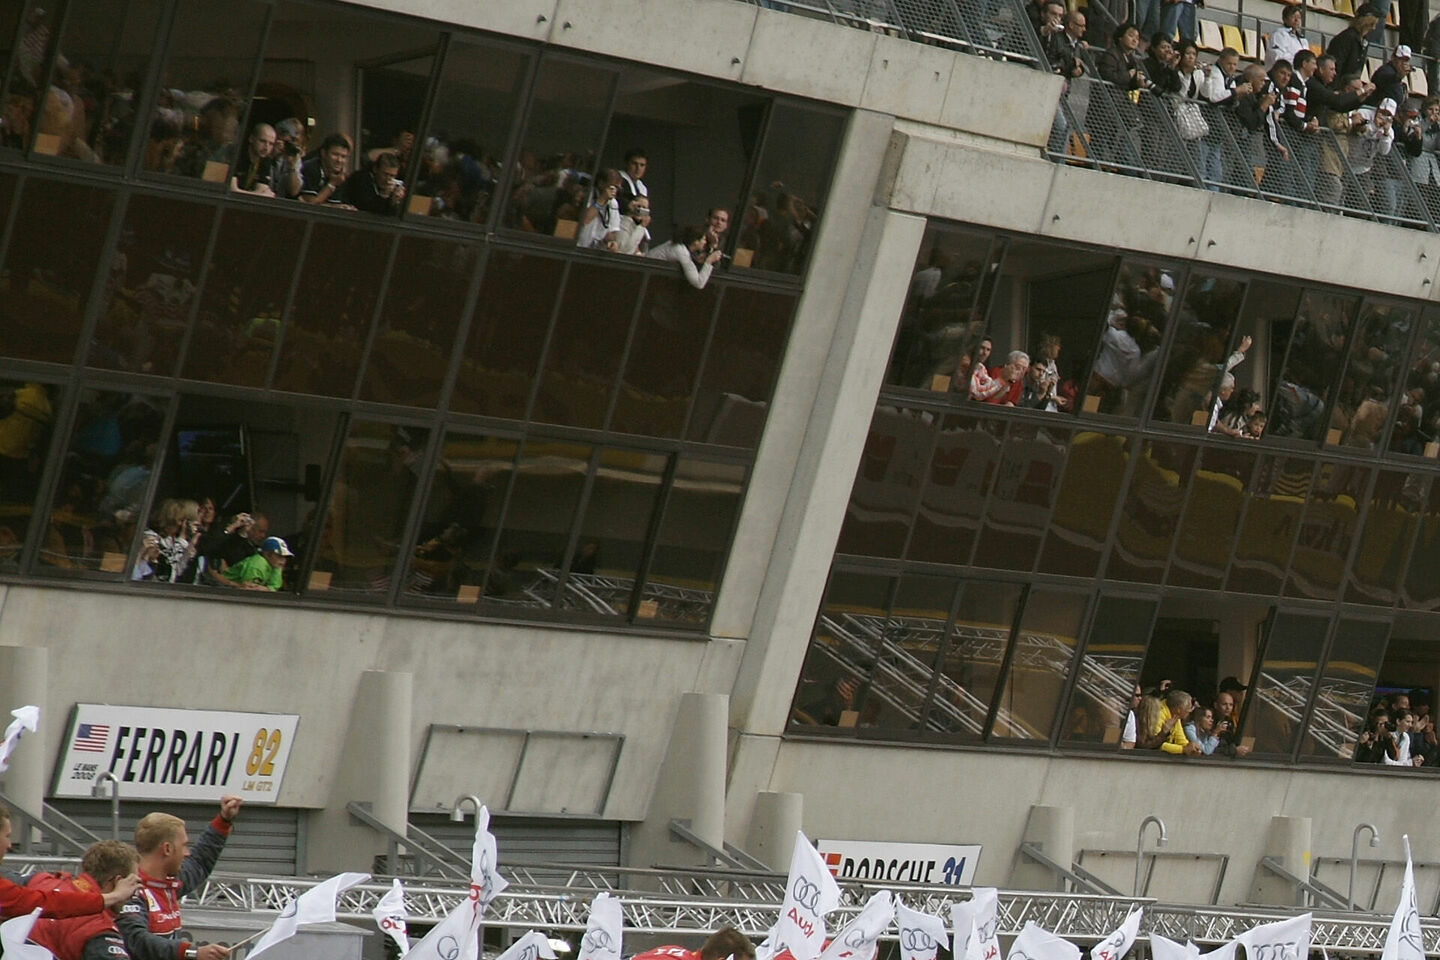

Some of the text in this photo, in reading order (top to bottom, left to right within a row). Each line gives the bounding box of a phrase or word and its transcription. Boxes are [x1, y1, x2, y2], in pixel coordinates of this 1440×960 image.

[109, 726, 282, 786] FERRARI 82
[786, 907, 815, 939] Audi
